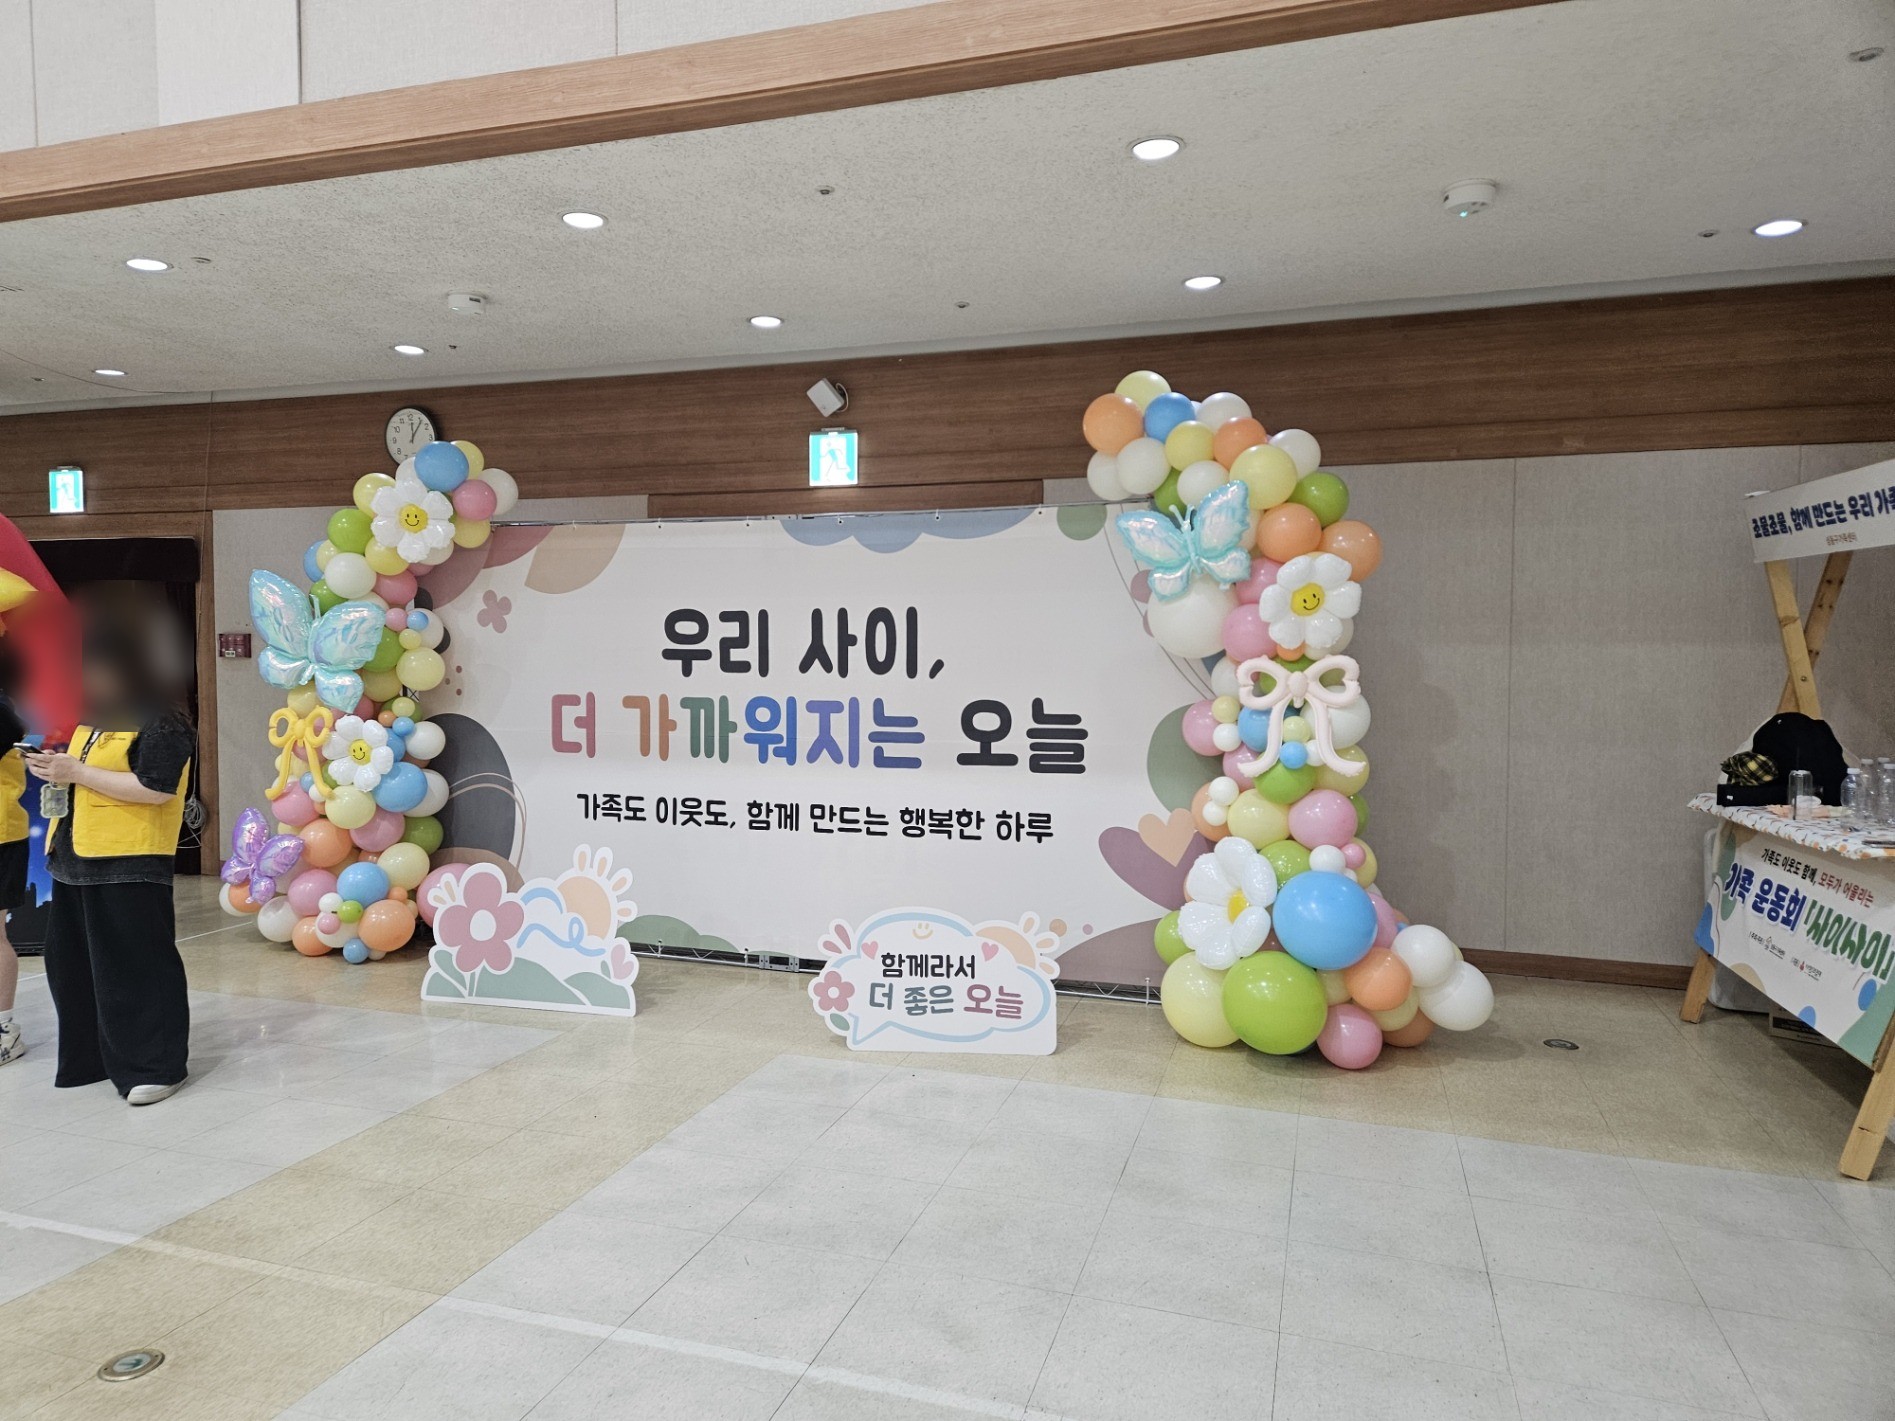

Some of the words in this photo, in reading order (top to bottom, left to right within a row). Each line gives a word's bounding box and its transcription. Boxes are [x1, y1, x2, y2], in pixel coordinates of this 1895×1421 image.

[392, 436, 397, 444] 9
[394, 425, 400, 433] 10
[397, 447, 401, 455] 8
[1790, 507, 1813, 531] 함께
[1812, 500, 1848, 528] 만드는
[1848, 492, 1874, 520] 우리
[661, 608, 769, 678] 우리
[798, 606, 945, 680] 사이,
[551, 691, 596, 758] 더
[622, 693, 925, 769] 가까워지는
[956, 697, 1089, 774] 오늘
[576, 793, 647, 822] 가족도
[656, 796, 736, 829] 이웃도,
[746, 800, 800, 832] 함께
[810, 804, 889, 836] 만드는
[899, 807, 985, 840] 행복한
[995, 810, 1054, 844] 하루
[1724, 862, 1755, 905] 가족
[1751, 878, 1807, 931] 운동회
[1761, 848, 1782, 866] 가족도
[1782, 856, 1802, 875] 이웃도
[1818, 872, 1843, 894] 모두가
[1843, 882, 1874, 908] 어울리는
[881, 952, 975, 979] 함께라서
[869, 982, 893, 1010] 더
[903, 985, 954, 1016] 좋은
[963, 984, 1024, 1020] 오늘
